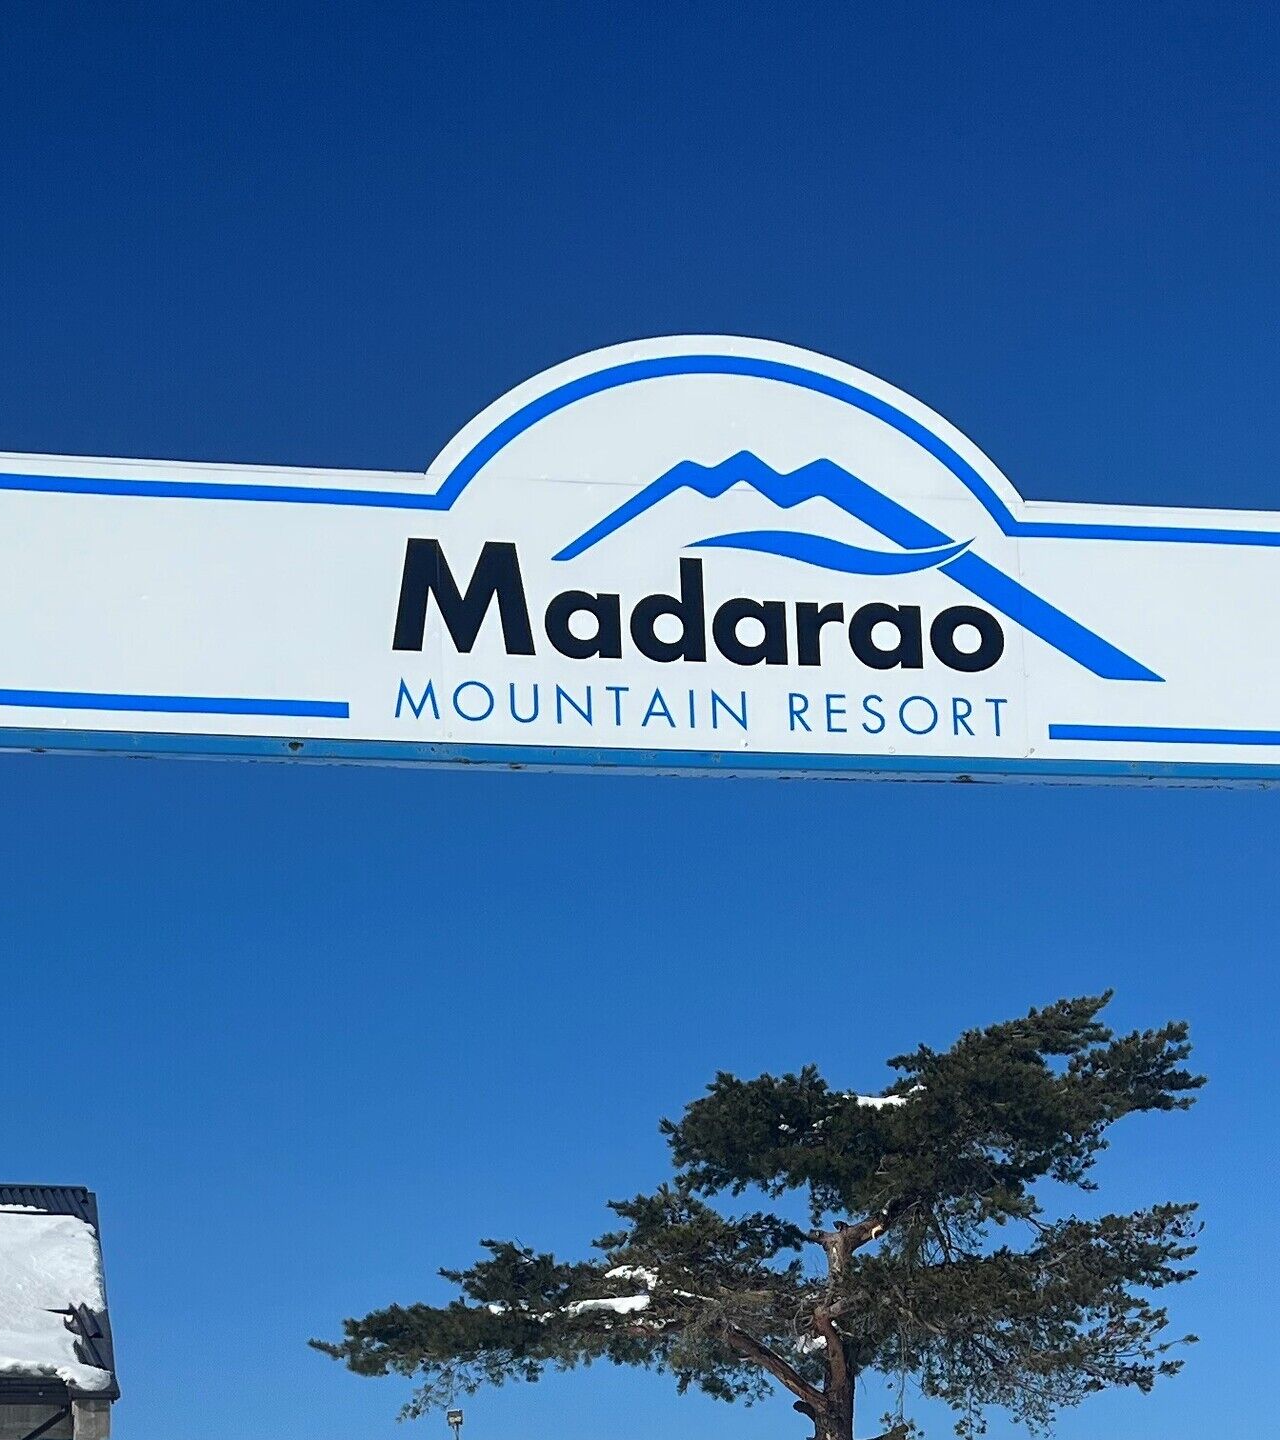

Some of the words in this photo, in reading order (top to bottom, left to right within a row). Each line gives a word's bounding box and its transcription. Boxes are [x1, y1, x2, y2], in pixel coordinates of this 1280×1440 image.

[392, 538, 1005, 672] Madarao
[395, 678, 748, 731] MOUNTAIN
[789, 692, 1008, 737] RESORT
